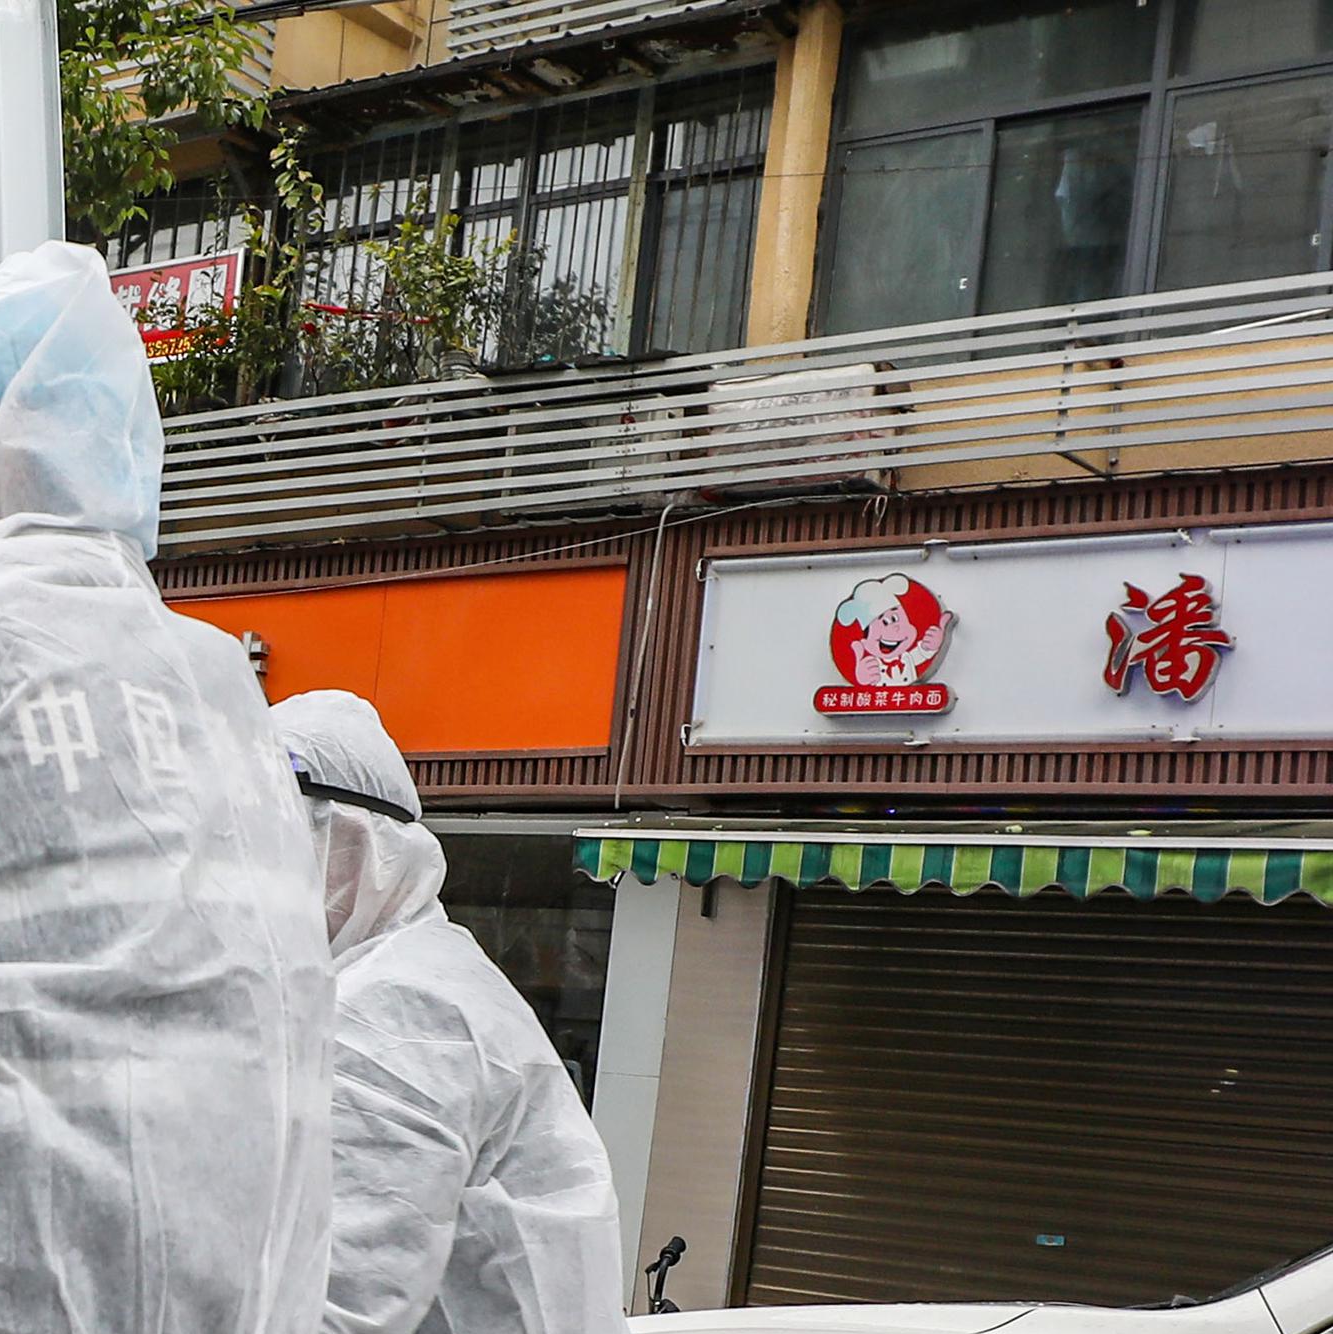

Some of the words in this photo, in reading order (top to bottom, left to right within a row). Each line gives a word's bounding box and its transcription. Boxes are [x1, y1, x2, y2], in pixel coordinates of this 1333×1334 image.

[1104, 573, 1232, 702] 潘
[822, 689, 942, 708] 秘制酸菜牛肉面
